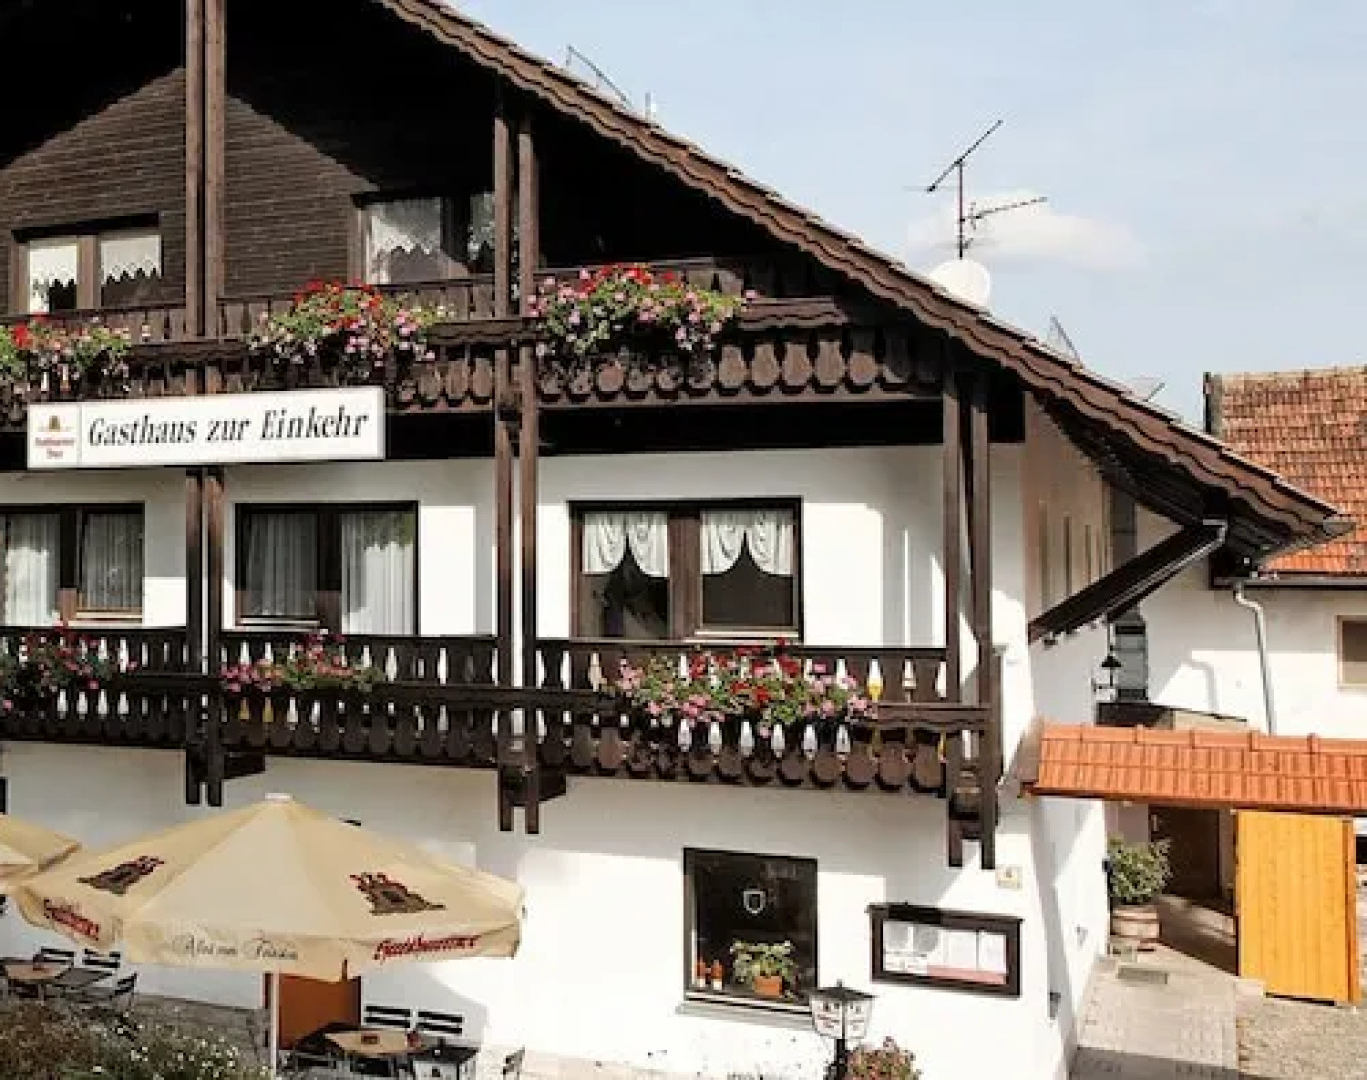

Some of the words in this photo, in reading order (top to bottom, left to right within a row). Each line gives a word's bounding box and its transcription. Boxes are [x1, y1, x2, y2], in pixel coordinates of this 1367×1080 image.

[87, 413, 198, 447] Gasthaus
[205, 417, 251, 443] zur
[259, 405, 370, 441] Einkehr
